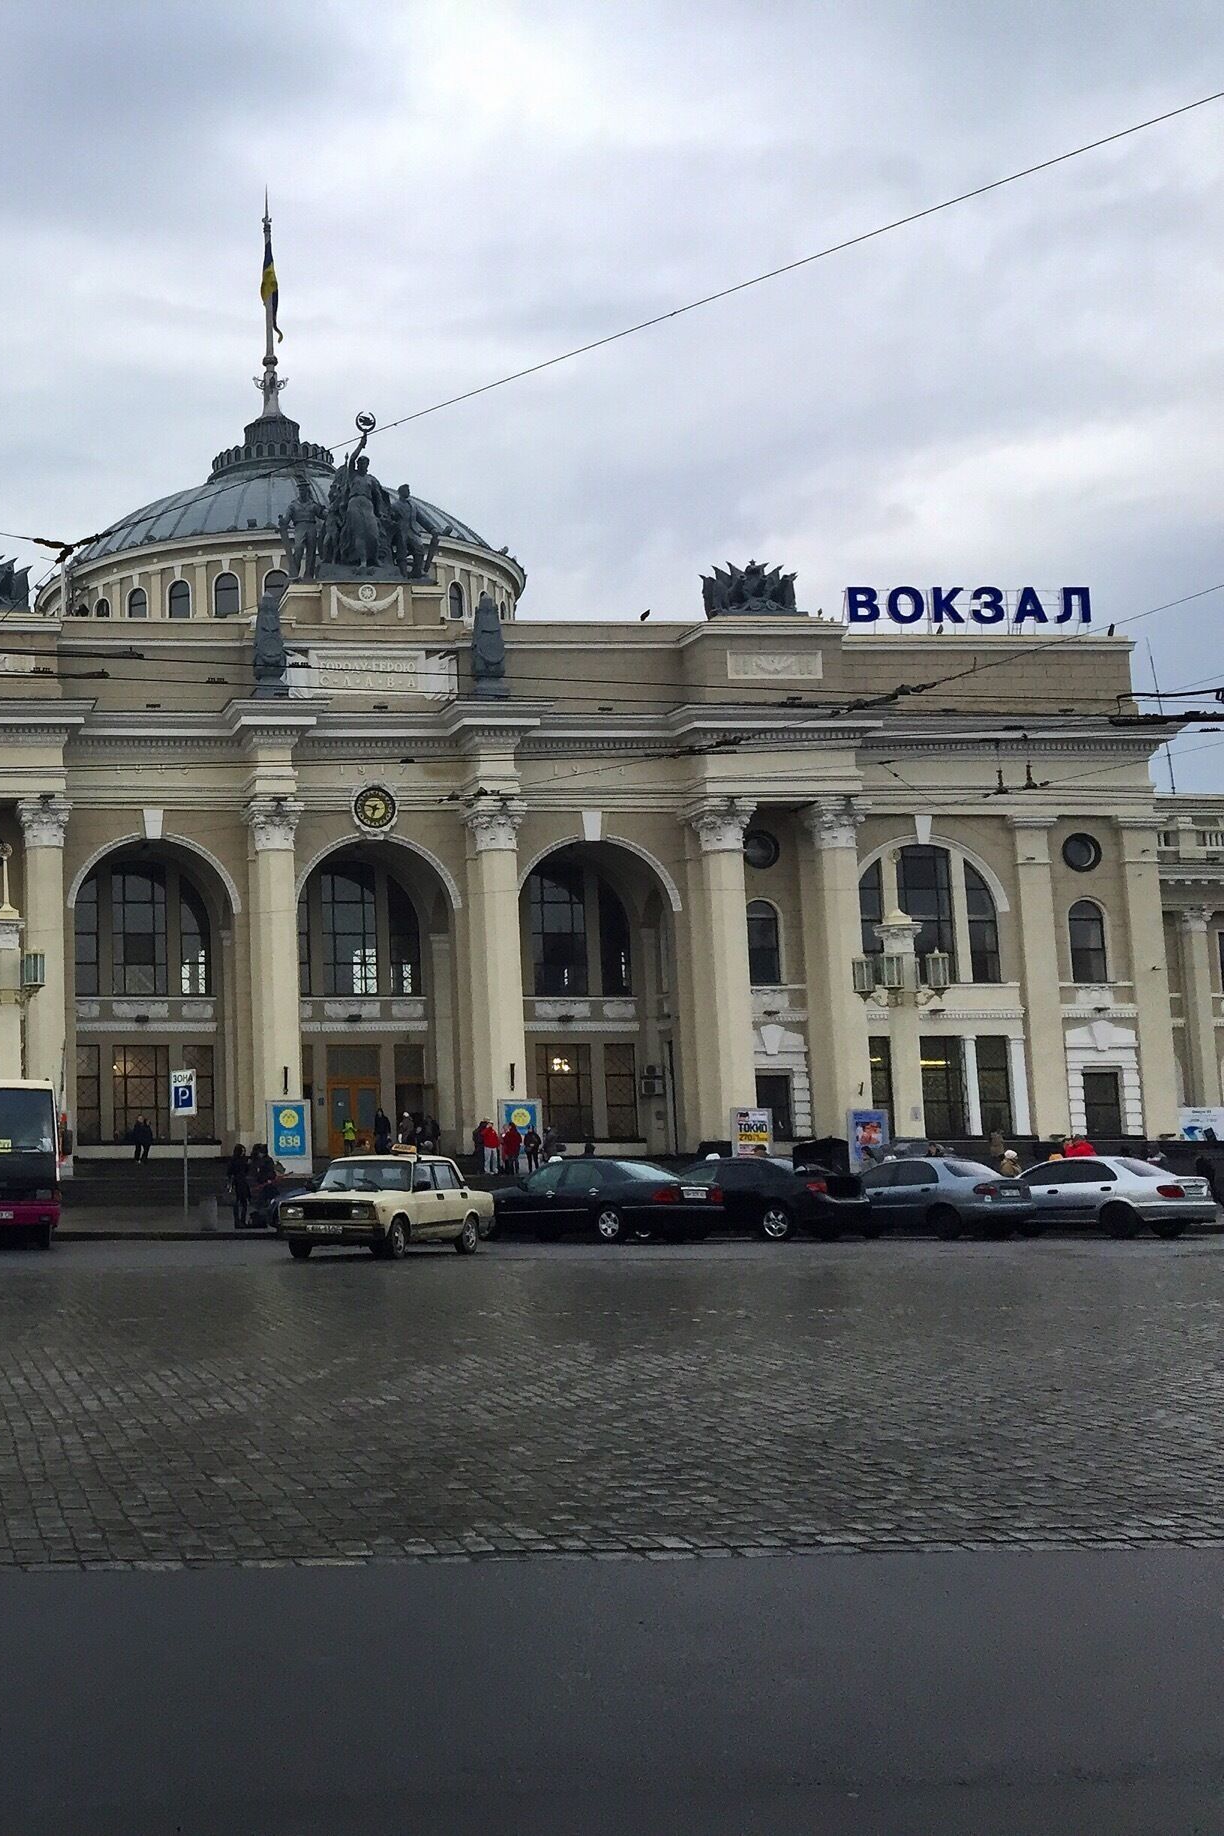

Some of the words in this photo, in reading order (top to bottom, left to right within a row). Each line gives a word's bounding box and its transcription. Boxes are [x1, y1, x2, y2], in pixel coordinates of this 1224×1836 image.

[847, 586, 1091, 624] ВОКЗАЛ
[172, 1073, 194, 1083] ЗОНА
[178, 1087, 190, 1106] P
[738, 1123, 767, 1133] ТОКИО
